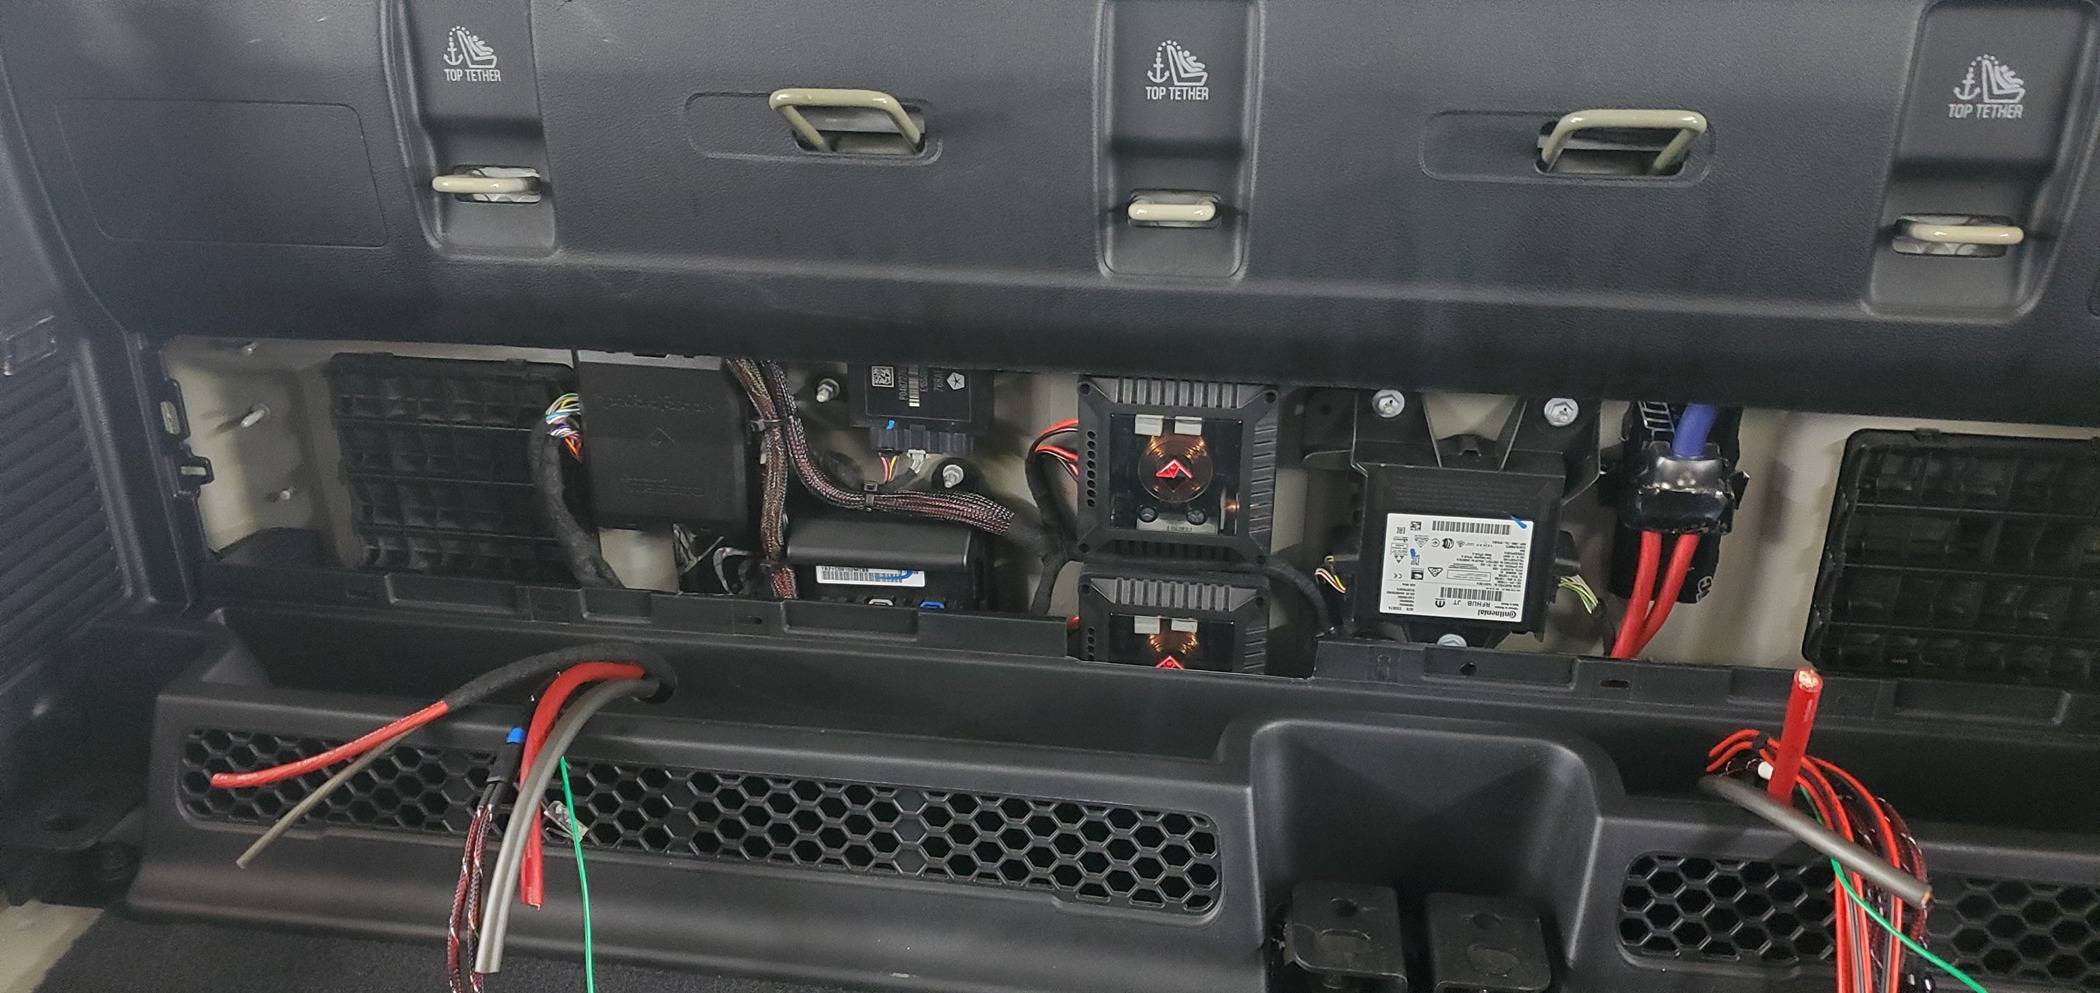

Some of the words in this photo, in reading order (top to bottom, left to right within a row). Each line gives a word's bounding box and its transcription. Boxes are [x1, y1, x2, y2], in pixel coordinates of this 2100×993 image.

[444, 69, 463, 82] TOP
[466, 69, 501, 82] TETHER
[1145, 86, 1166, 100] TOP
[1169, 86, 1209, 100] TETHER
[1948, 104, 1973, 118] TOP
[1976, 104, 2024, 119] TETHER
[1467, 600, 1491, 608] RFHUB
